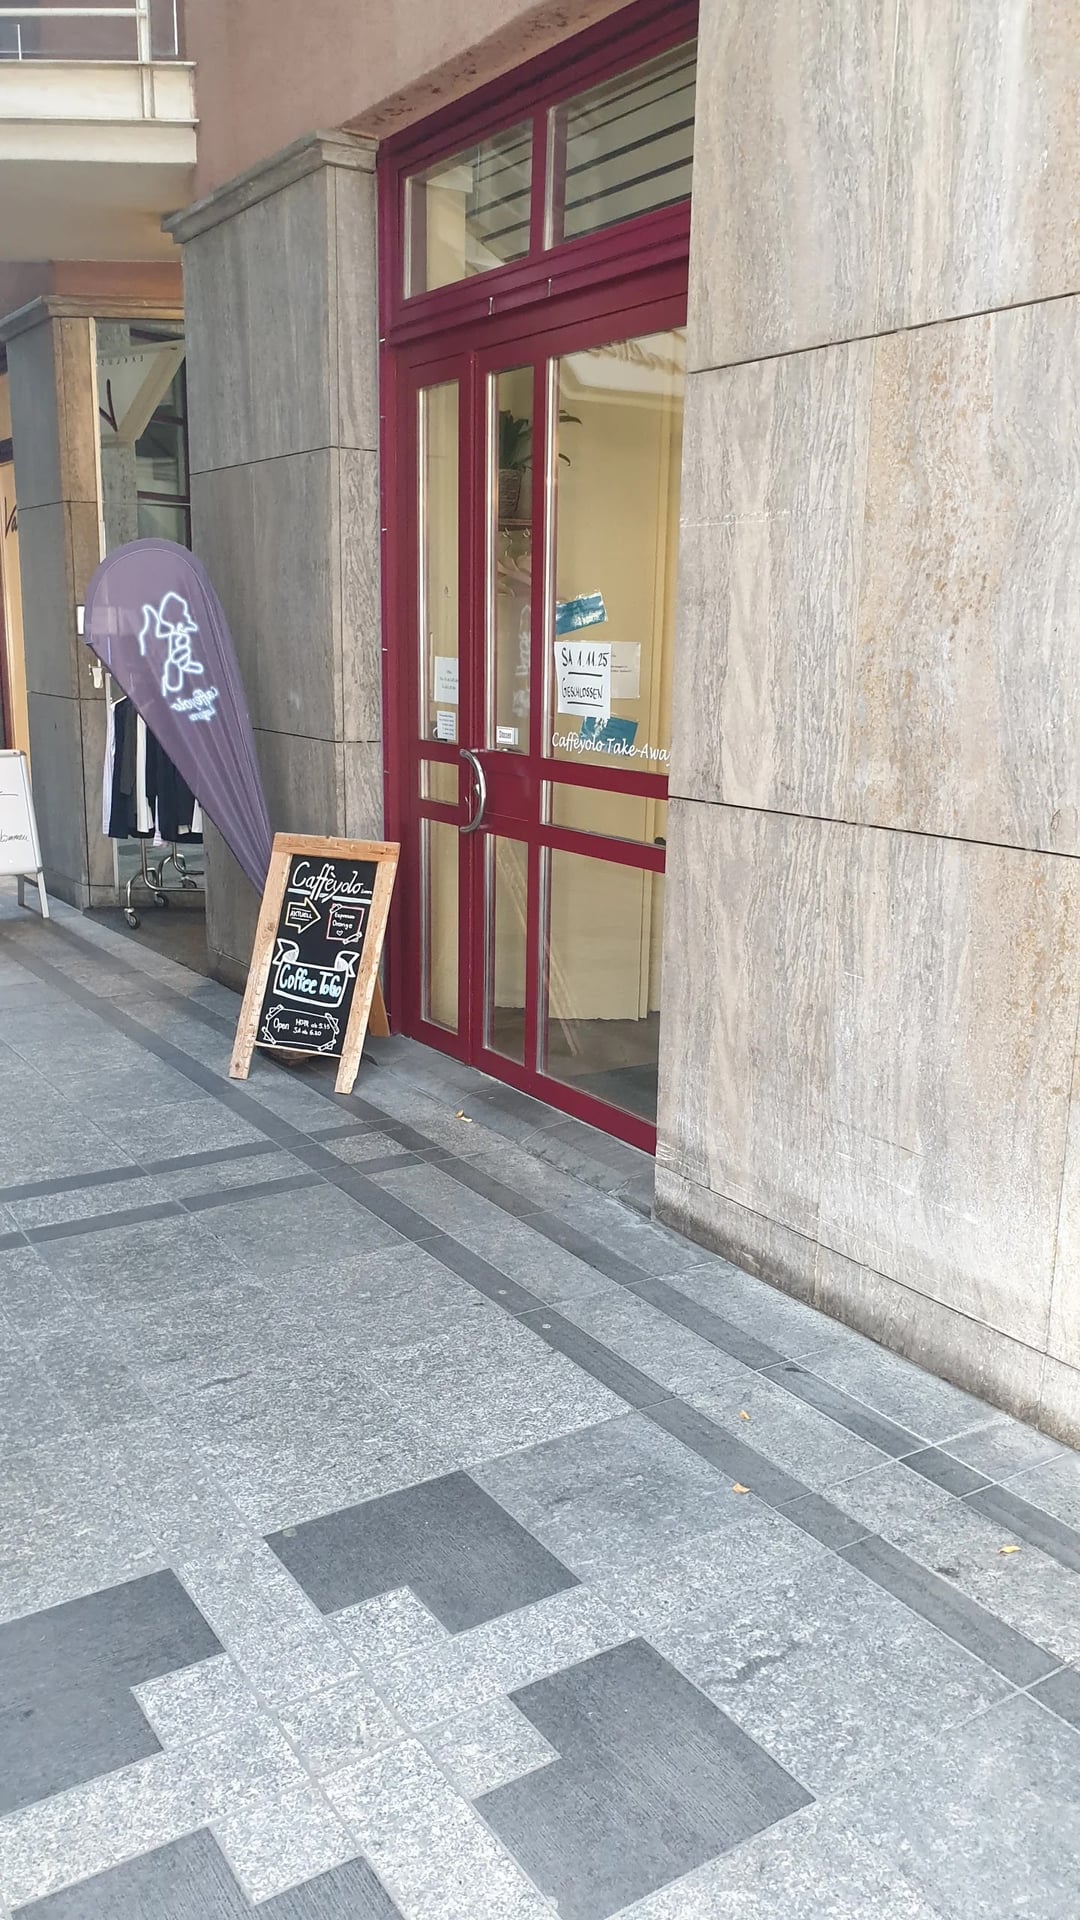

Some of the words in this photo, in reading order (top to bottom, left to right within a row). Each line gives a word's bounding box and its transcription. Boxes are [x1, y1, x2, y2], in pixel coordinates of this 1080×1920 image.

[561, 647, 573, 667] SA
[561, 677, 604, 700] GESCHLOSSEN
[292, 861, 364, 904] Caffèyolo
[289, 910, 313, 919] AKTUELL
[279, 963, 318, 994] Coffee
[273, 1017, 290, 1033] Open
